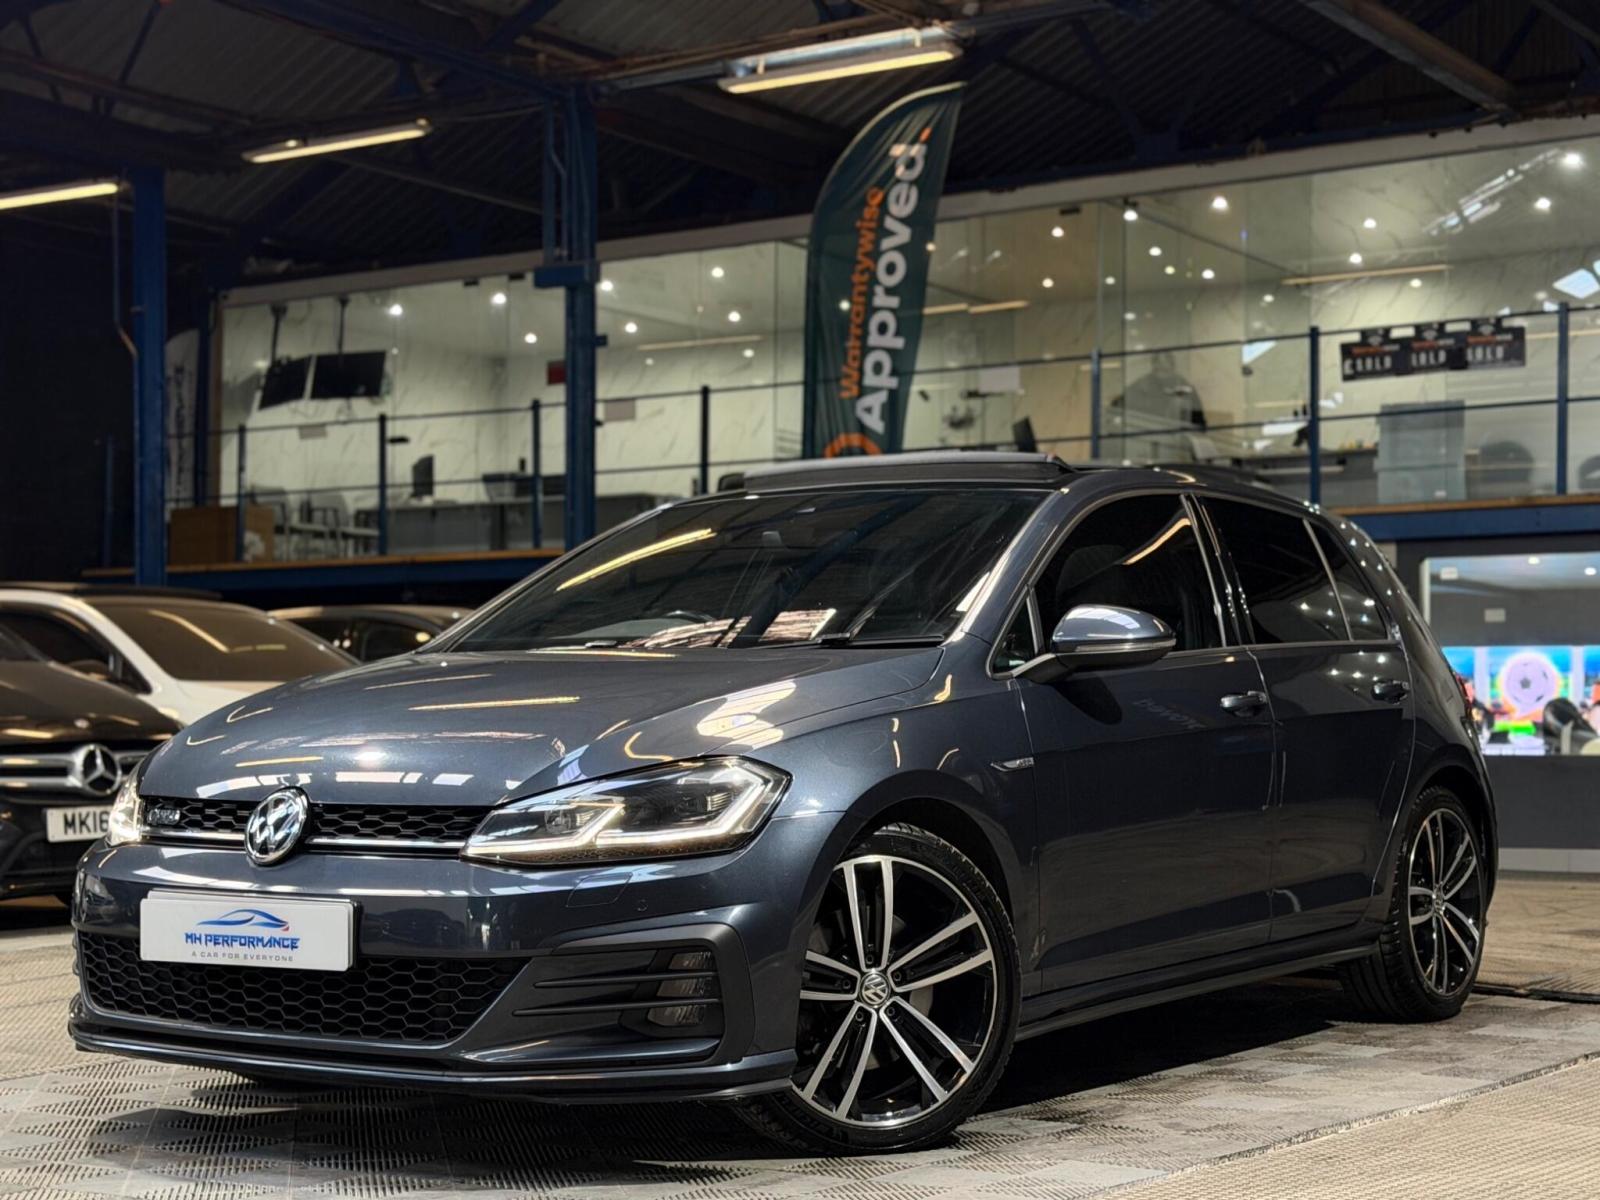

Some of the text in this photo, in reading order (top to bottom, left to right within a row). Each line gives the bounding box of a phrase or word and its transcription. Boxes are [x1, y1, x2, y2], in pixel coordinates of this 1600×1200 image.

[841, 185, 886, 399] Warrantywise
[184, 932, 300, 951] MH PERFORMANCE
[200, 951, 219, 959] CAR
[222, 952, 240, 960] FOR
[243, 953, 293, 962] EVERYONE
